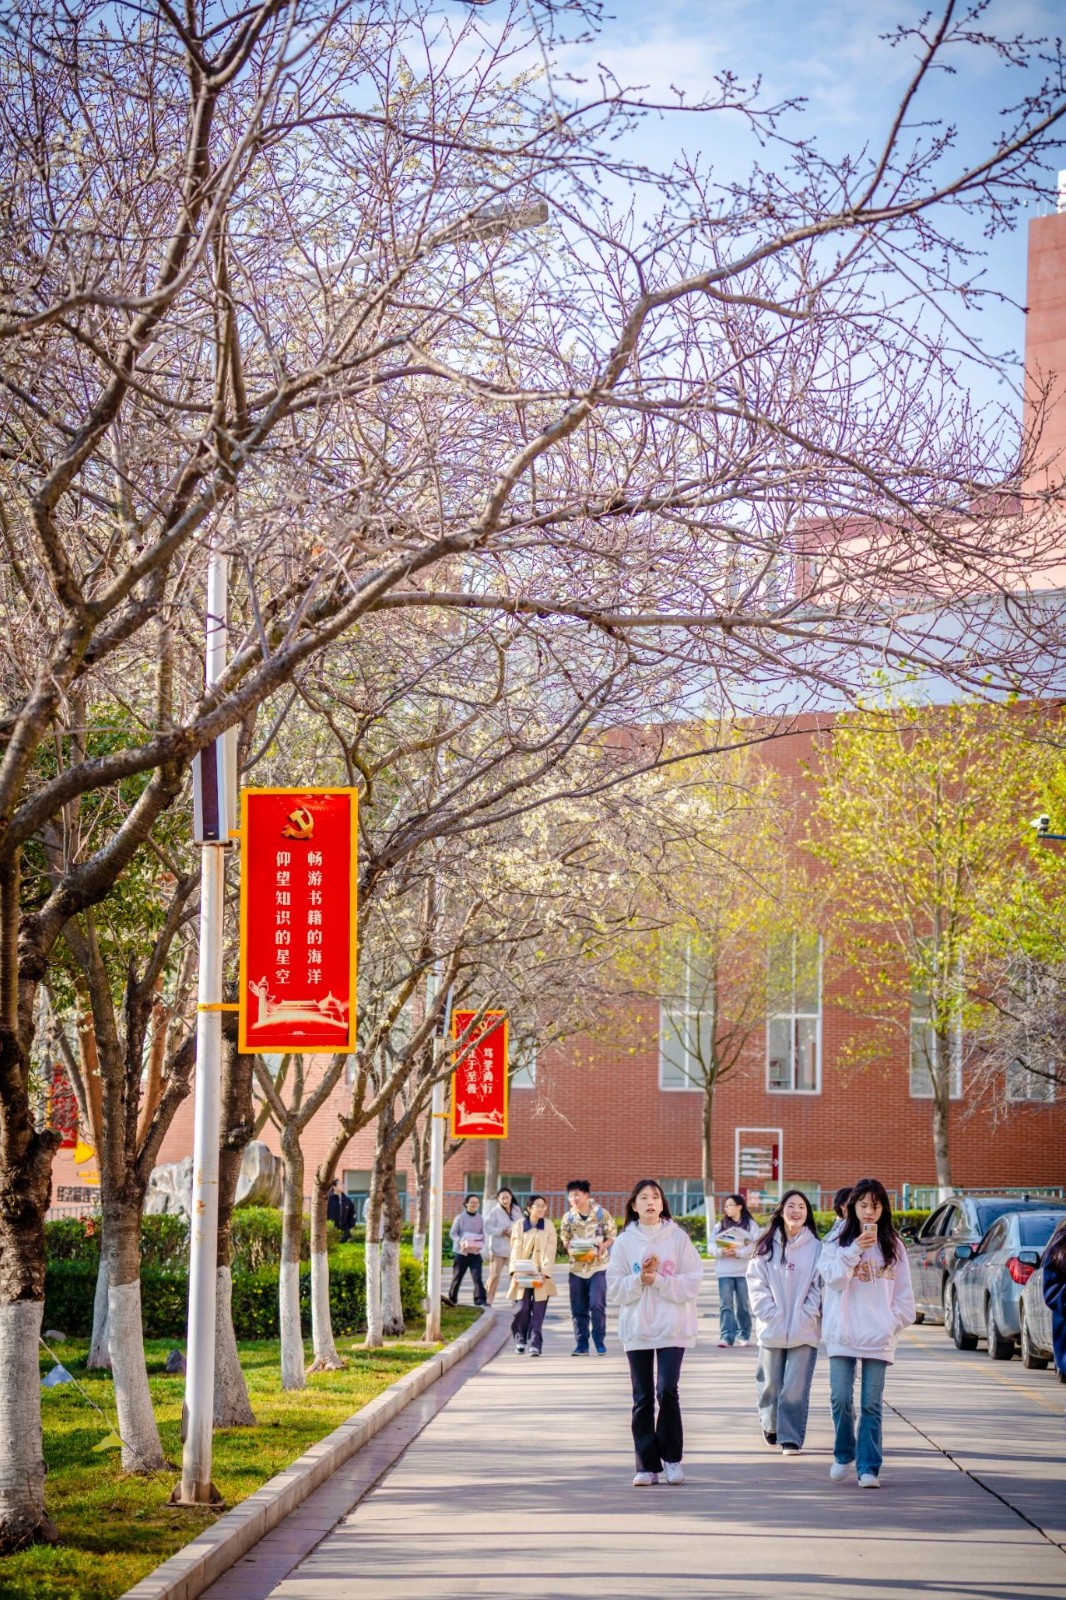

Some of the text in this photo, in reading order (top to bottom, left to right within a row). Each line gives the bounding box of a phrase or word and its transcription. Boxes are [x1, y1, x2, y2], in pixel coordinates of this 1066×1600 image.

[275, 851, 291, 984] 仰望知识的星空
[307, 851, 322, 984] 畅游书籍的海洋
